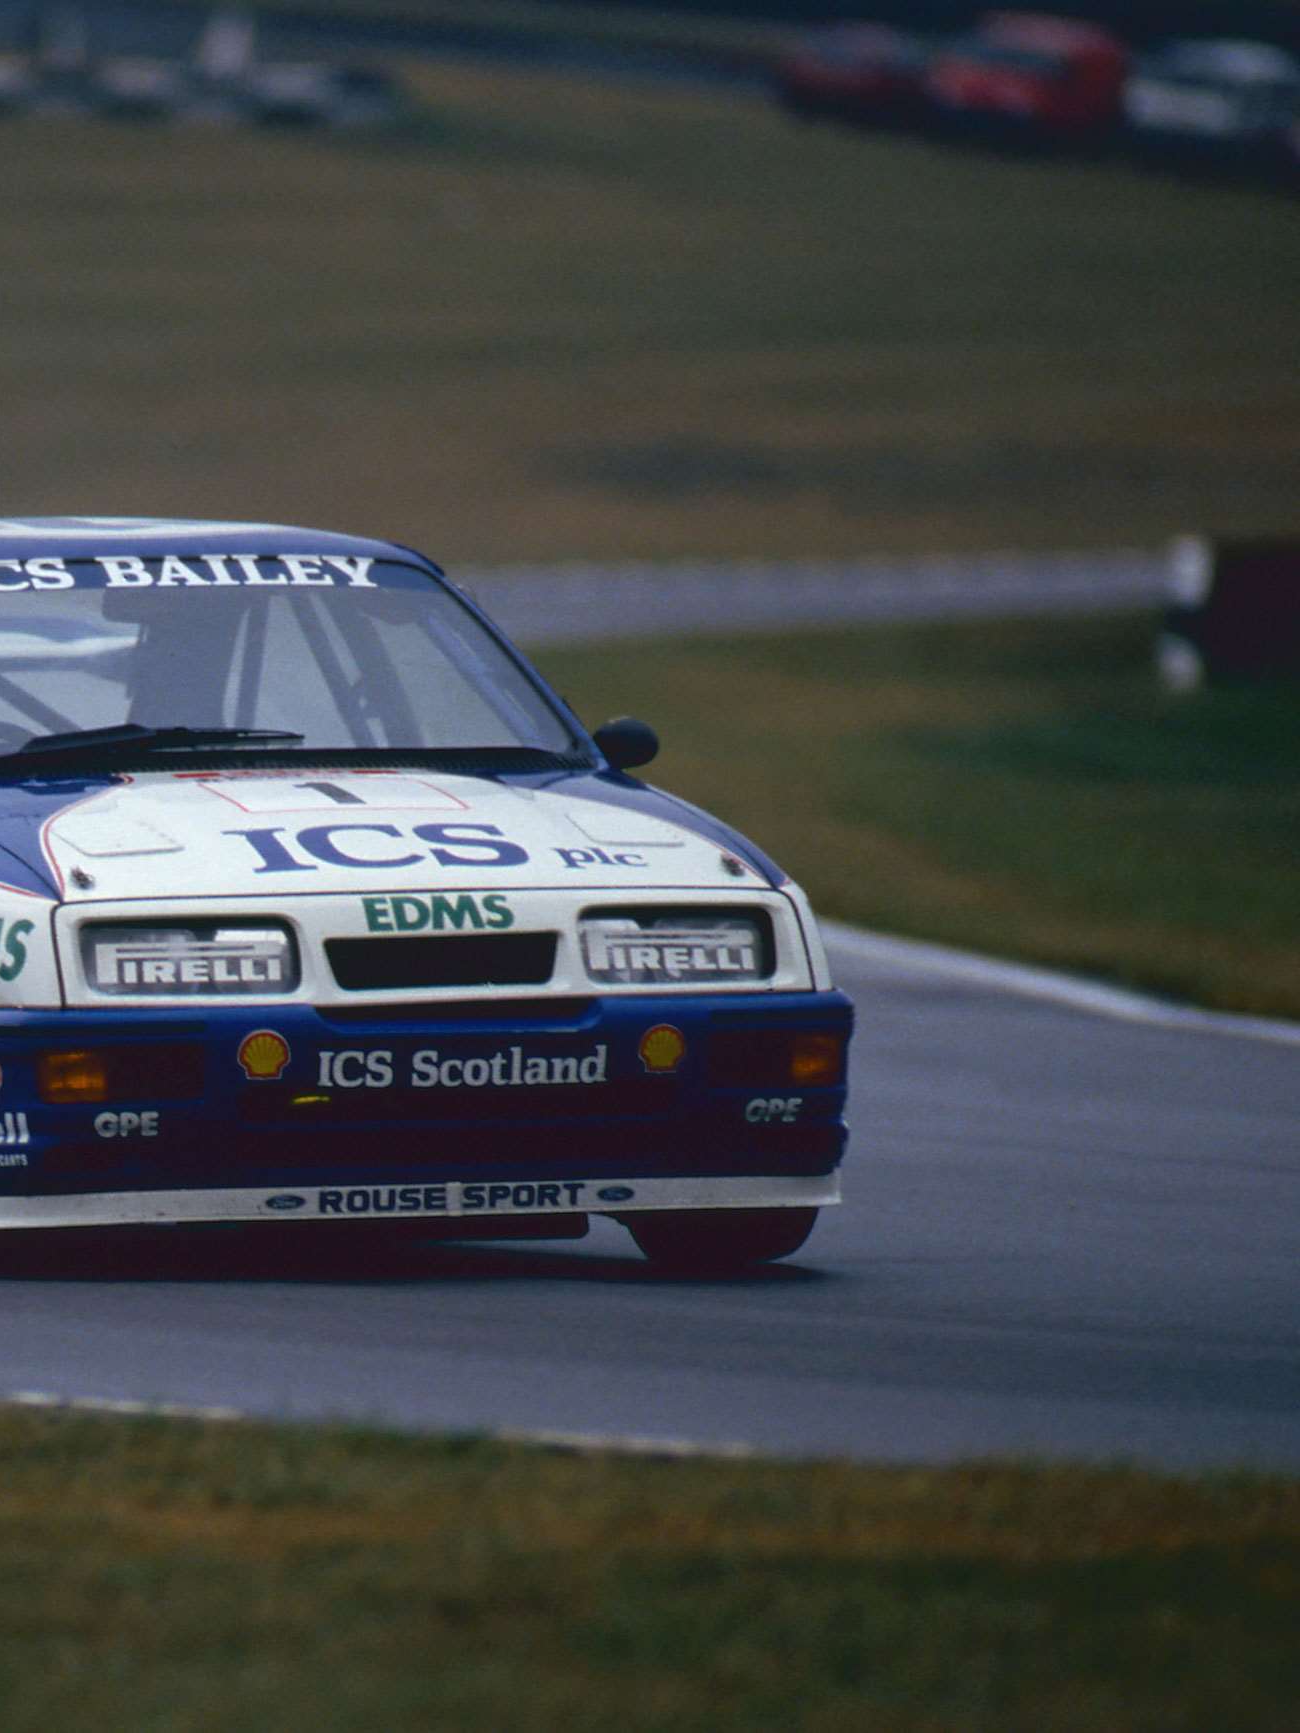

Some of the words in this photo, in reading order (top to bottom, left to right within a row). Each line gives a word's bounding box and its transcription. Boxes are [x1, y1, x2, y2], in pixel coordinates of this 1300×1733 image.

[93, 554, 378, 588] BAILEY
[293, 782, 367, 804] 1
[220, 823, 531, 875] ICS
[553, 842, 649, 870] plc
[360, 893, 515, 933] EDMS
[95, 942, 288, 984] PIRELLI
[587, 929, 757, 970] PIRELLI
[317, 1050, 393, 1089] ICS
[411, 1045, 609, 1087] Scotland
[93, 1111, 159, 1138] GPE
[745, 1097, 803, 1122] GPE
[318, 1186, 446, 1214] ROUSE
[460, 1183, 586, 1209] SPORT
